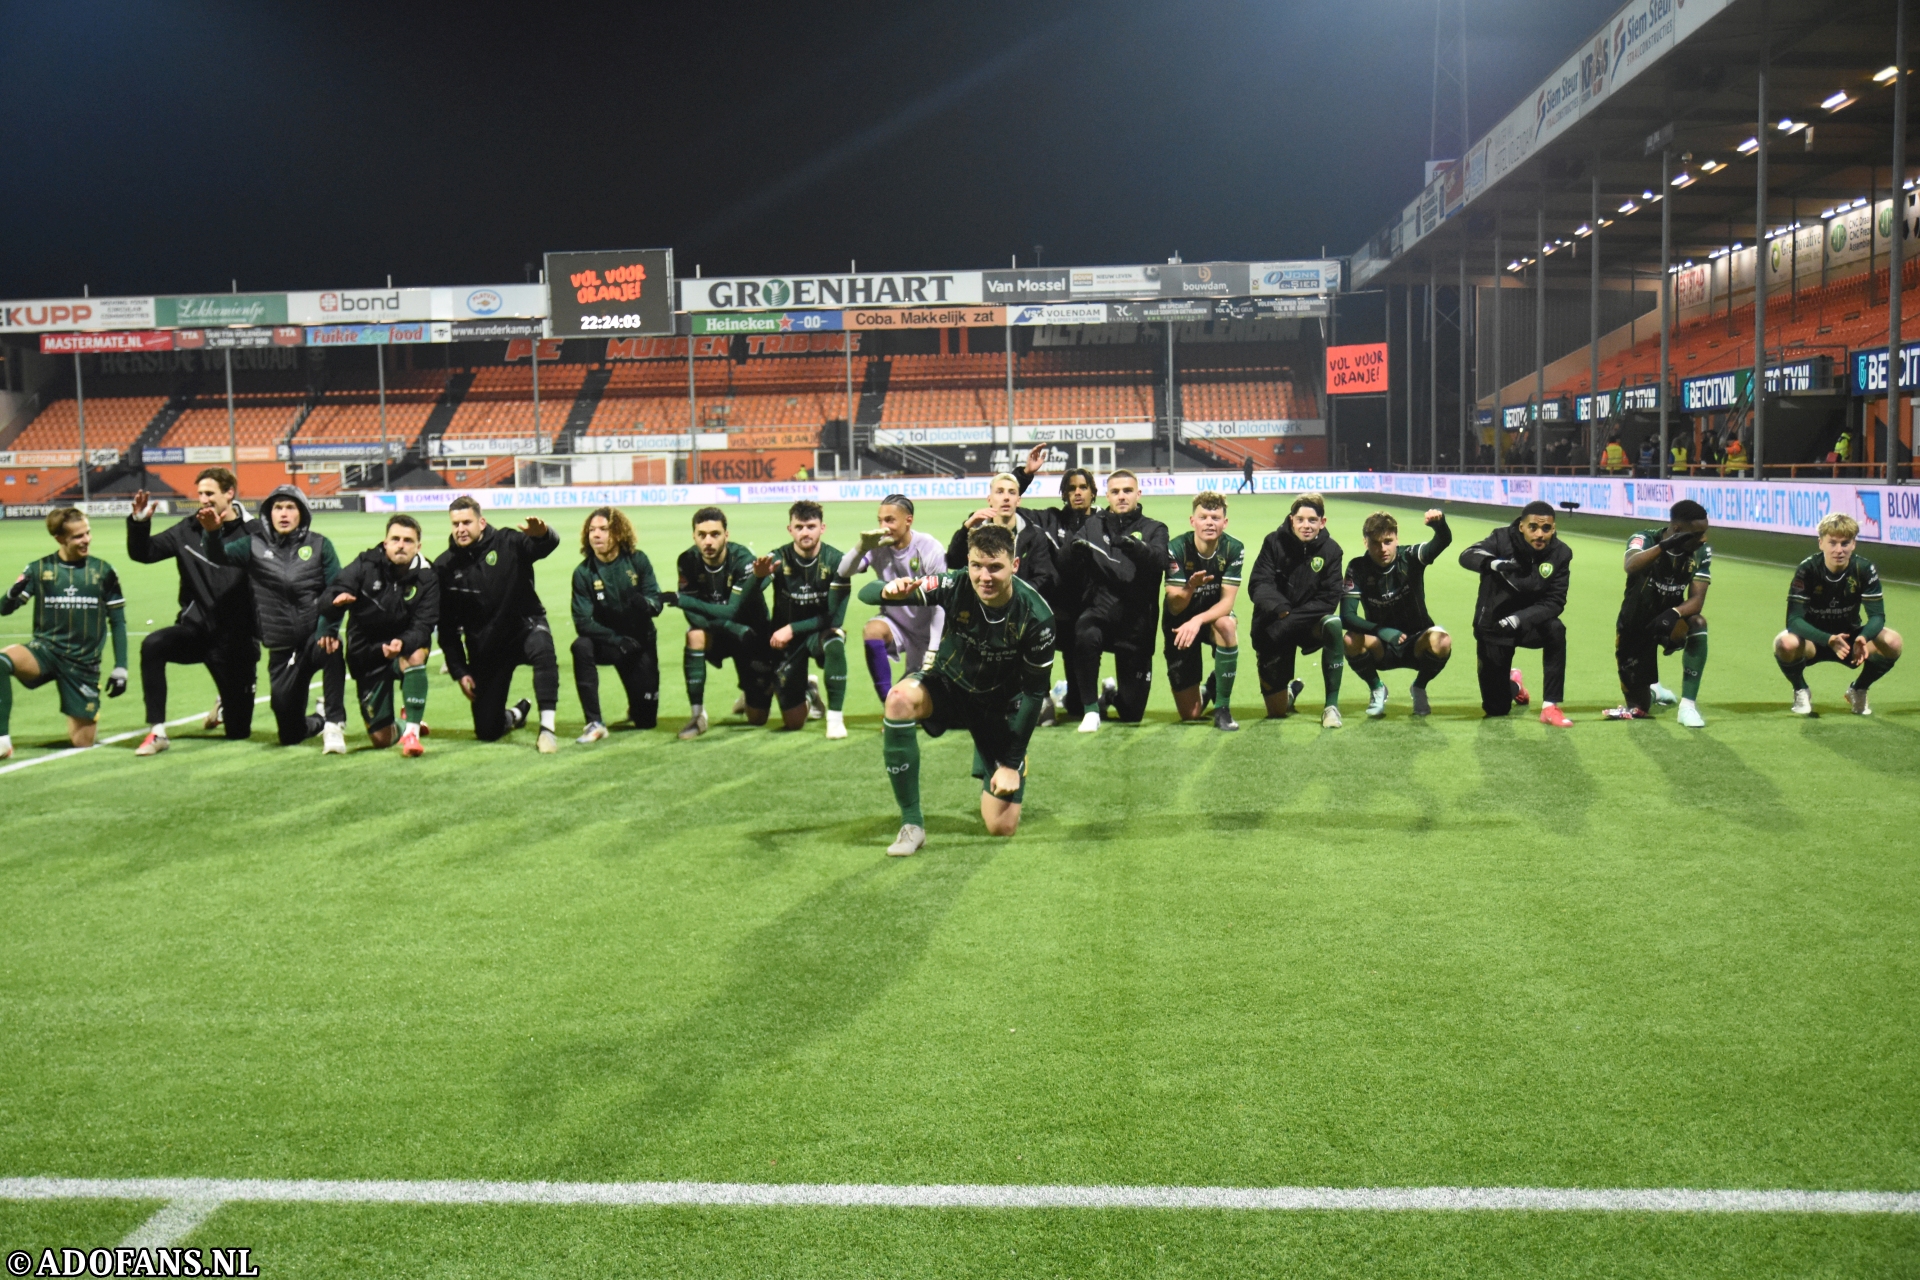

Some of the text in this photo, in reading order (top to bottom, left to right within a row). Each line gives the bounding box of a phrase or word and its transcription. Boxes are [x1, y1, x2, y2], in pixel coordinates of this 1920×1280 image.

[1627, 13, 1647, 46] Siem
[1781, 230, 1821, 257] Grenovative
[570, 264, 647, 288] VOL VOOR
[1285, 270, 1318, 279] JONK
[577, 281, 642, 304] ORANJE!
[708, 274, 953, 308] GROENHART
[987, 277, 1066, 294] Van Mossel
[1183, 281, 1227, 291] bouwdam
[341, 291, 400, 311] bond
[580, 313, 642, 331] 22:24:03
[856, 309, 995, 328] Coba. Makkelijk zat
[1046, 309, 1101, 318] VOLENDAM
[279, 328, 297, 338] TTA
[452, 323, 543, 336] www.runderkamp.nl
[706, 316, 775, 333] Heineken
[44, 336, 143, 351] MASTERMATE.NL
[181, 331, 199, 341] TTA
[746, 333, 862, 355] TRIBUNE
[1329, 350, 1384, 372] VOL VOOR
[1333, 366, 1381, 387] ORANJE!
[1689, 374, 1737, 409] BETCITY.NL
[909, 430, 928, 442] tol
[1059, 427, 1116, 440] INBUCO
[1217, 421, 1303, 437] tol plaatwerk
[461, 441, 485, 452] Lou
[617, 435, 692, 453] tol plaatwer
[747, 485, 819, 496] BLOMMESTEIN
[840, 484, 862, 499] UW
[905, 482, 928, 496] EEN
[931, 480, 989, 496] FACELIFT
[1196, 478, 1218, 491] UW
[1261, 476, 1287, 490] EEN
[1291, 475, 1347, 489] FACELIFT
[492, 488, 689, 507] UW PAND EEN FACELIFT NODG?
[1637, 483, 1675, 503] BLOMMESTEIN
[1725, 488, 1742, 521] EEN
[1745, 488, 1786, 525] FACELIFT
[1789, 490, 1831, 529] NODIG?
[44, 595, 99, 604] HOMMERSON
[886, 763, 909, 775] ADO
